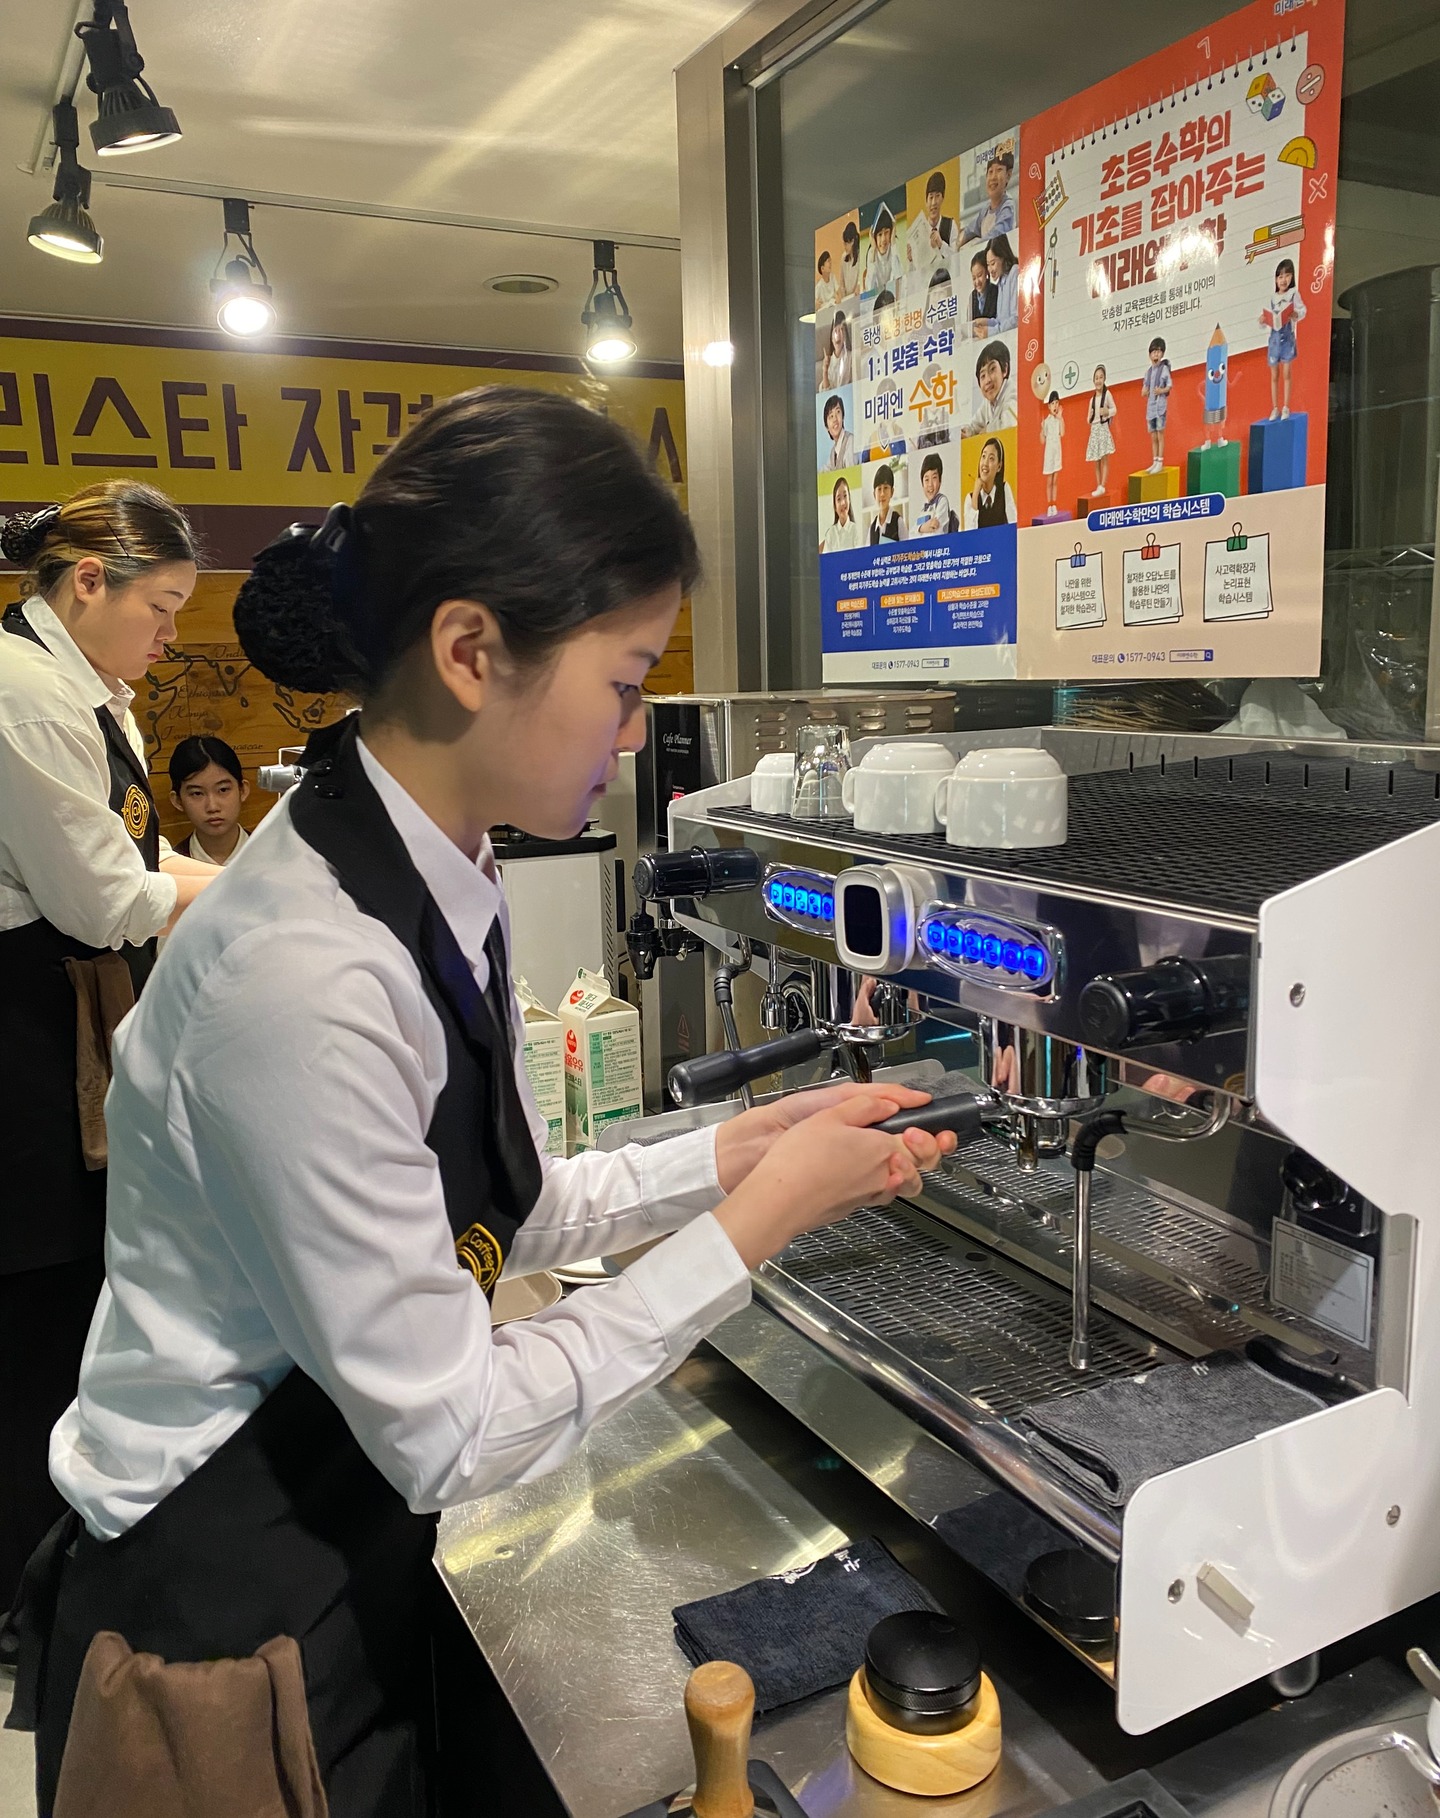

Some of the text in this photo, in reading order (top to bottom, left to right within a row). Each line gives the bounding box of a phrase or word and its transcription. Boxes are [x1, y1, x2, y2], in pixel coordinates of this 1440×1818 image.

[1100, 110, 1231, 200] 초등수학의
[1071, 152, 1266, 257] 기초를 잡아주는
[1101, 274, 1216, 322] 맞춤형 교육콘텐츠를 통해 내 아이의
[863, 325, 881, 346] 학생
[904, 309, 922, 333] 한명
[926, 295, 958, 324] 수준별
[1112, 296, 1203, 332] 자기주도학습이 진행됩니다.
[892, 341, 919, 374] 맞춤
[923, 329, 955, 362] 수학
[865, 369, 958, 423] 미래엔 수학
[1099, 498, 1210, 528] 미래엔수학만의 학습시스템
[1145, 569, 1176, 581] 오답노트를
[1215, 562, 1256, 576] 사고력확장과
[1223, 577, 1251, 590] 논리표현
[1154, 597, 1172, 608] 만들기
[1219, 592, 1253, 604] 학습시스템
[893, 660, 920, 668] 1577-0943
[1091, 654, 1115, 664] 대표문의
[1126, 652, 1166, 662] 1577-0943
[662, 732, 693, 746] Cafe Planner
[469, 1232, 495, 1271] Coffee
